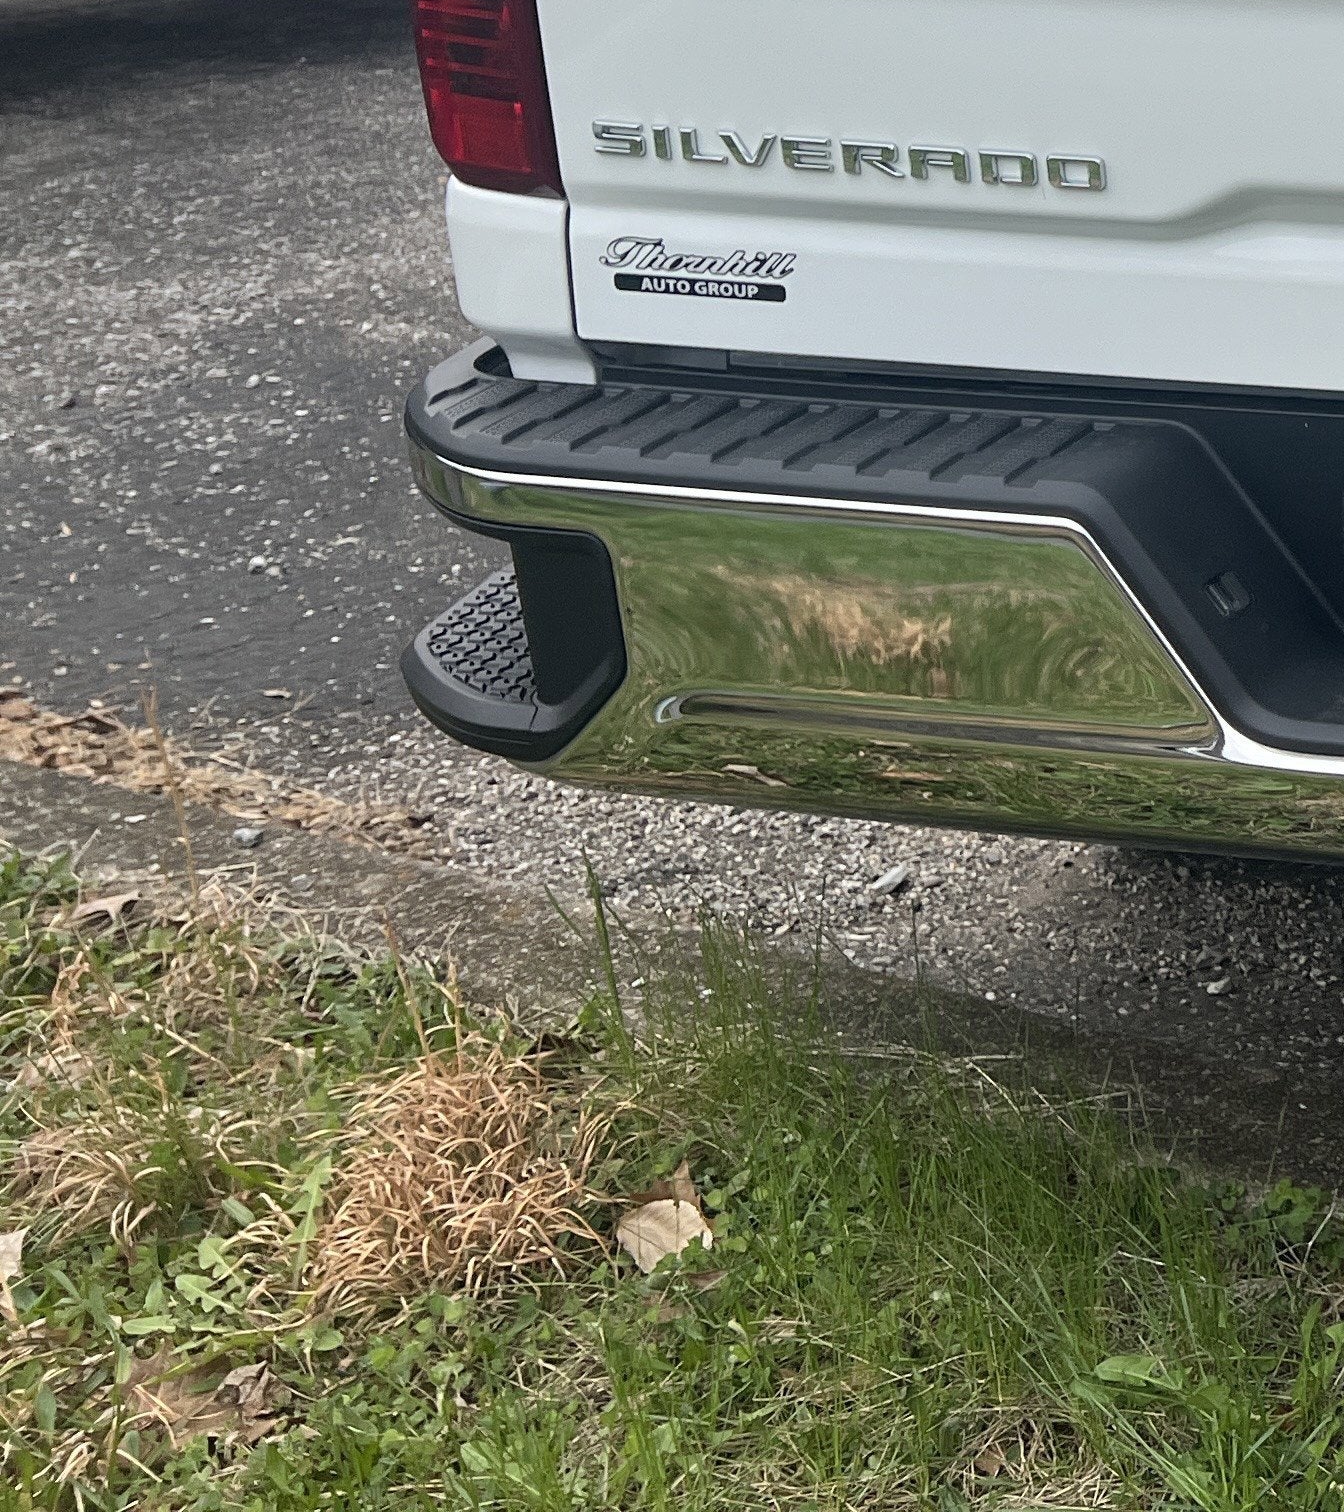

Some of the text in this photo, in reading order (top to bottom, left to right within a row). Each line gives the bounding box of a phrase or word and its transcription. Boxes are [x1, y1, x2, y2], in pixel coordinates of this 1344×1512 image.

[592, 119, 1107, 190] SILVERADO
[599, 236, 797, 279] Thornhill
[640, 277, 759, 299] AUTO GROUP
